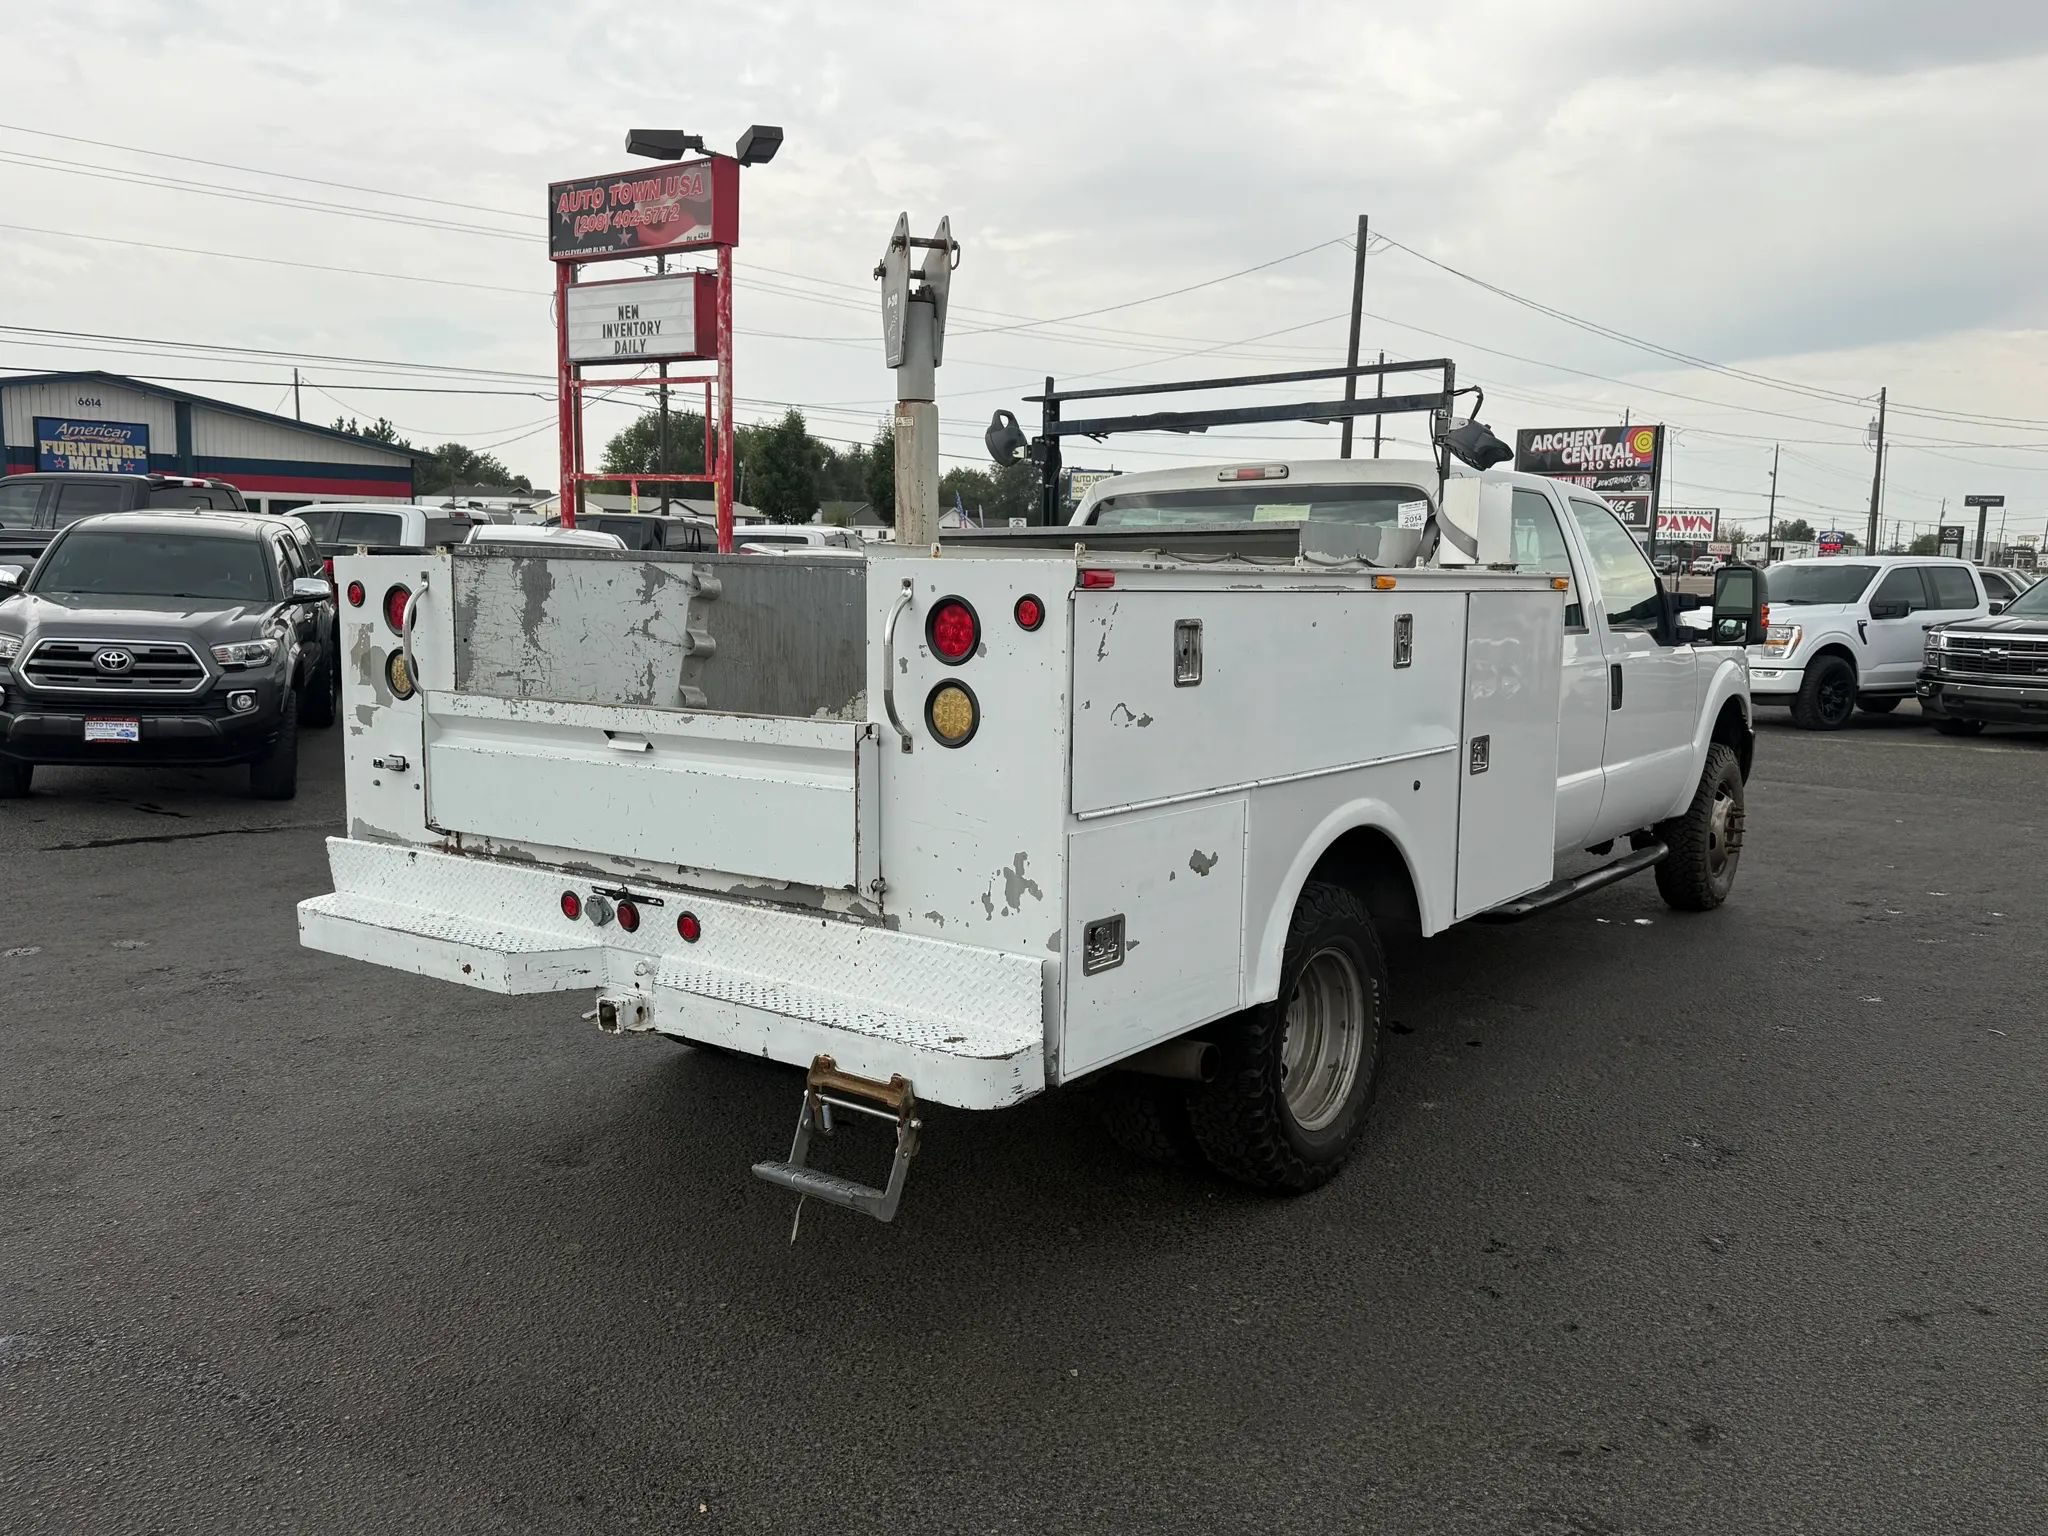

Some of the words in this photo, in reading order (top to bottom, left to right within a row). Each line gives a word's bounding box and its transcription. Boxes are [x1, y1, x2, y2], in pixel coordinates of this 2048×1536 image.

[557, 187, 604, 213] AUTO
[609, 178, 661, 206] TOWN
[665, 172, 703, 197] USA
[574, 212, 609, 236] (208)
[613, 203, 680, 228] 402-5772
[565, 247, 592, 256] CLEVELAND
[618, 304, 639, 320] NEW
[602, 320, 662, 338] INVENTORY
[614, 338, 647, 354] DAILY
[78, 397, 101, 407] 6614
[55, 423, 131, 438] American
[1530, 428, 1605, 452] ARCHERY
[40, 440, 147, 459] FURNITURE
[1561, 442, 1634, 465] CENTRAL
[68, 456, 121, 472] MART
[1580, 461, 1604, 471] PRO
[1609, 457, 1641, 469] SHOP
[1072, 475, 1091, 483] AUTO
[1607, 500, 1636, 513] NGE
[1620, 512, 1635, 521] AIR
[1656, 515, 1713, 532] PAWN
